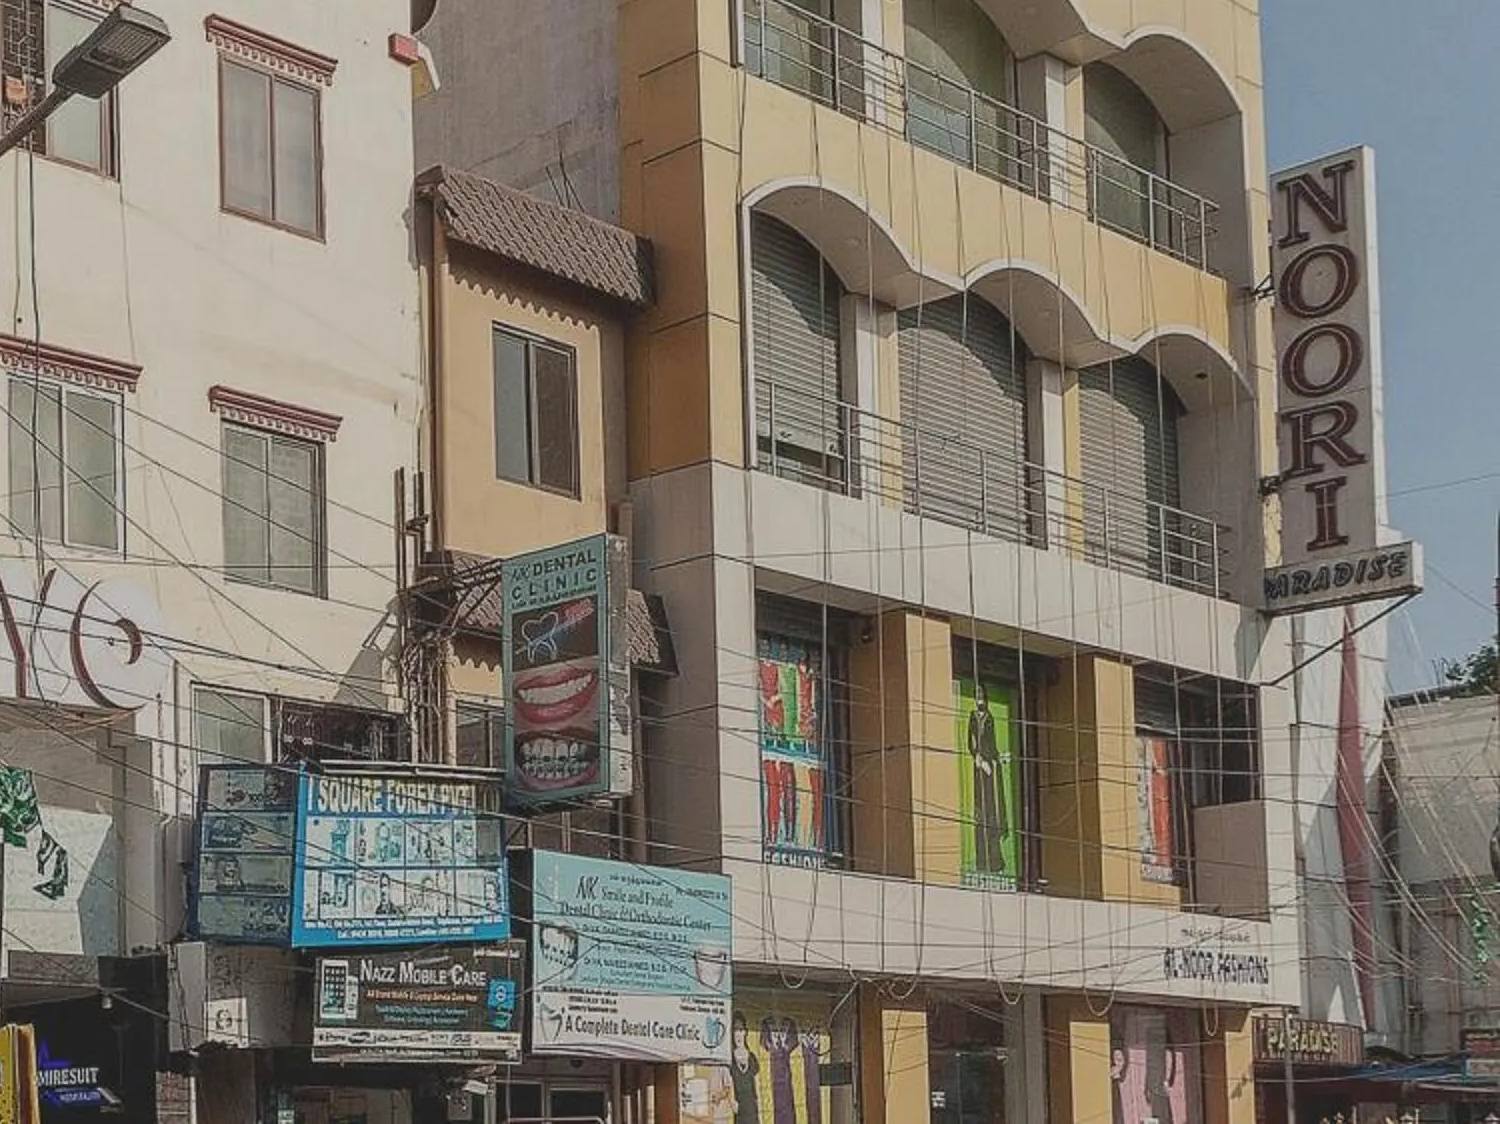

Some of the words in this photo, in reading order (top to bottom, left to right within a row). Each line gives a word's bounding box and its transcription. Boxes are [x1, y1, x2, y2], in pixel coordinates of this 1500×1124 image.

[1276, 159, 1367, 552] NOORI
[534, 549, 597, 577] DENTAL
[512, 569, 597, 600] CLINIC
[317, 776, 384, 813] SQUARE
[387, 778, 439, 813] FOREX
[400, 961, 447, 986] MOBILE
[449, 963, 488, 987] CARE
